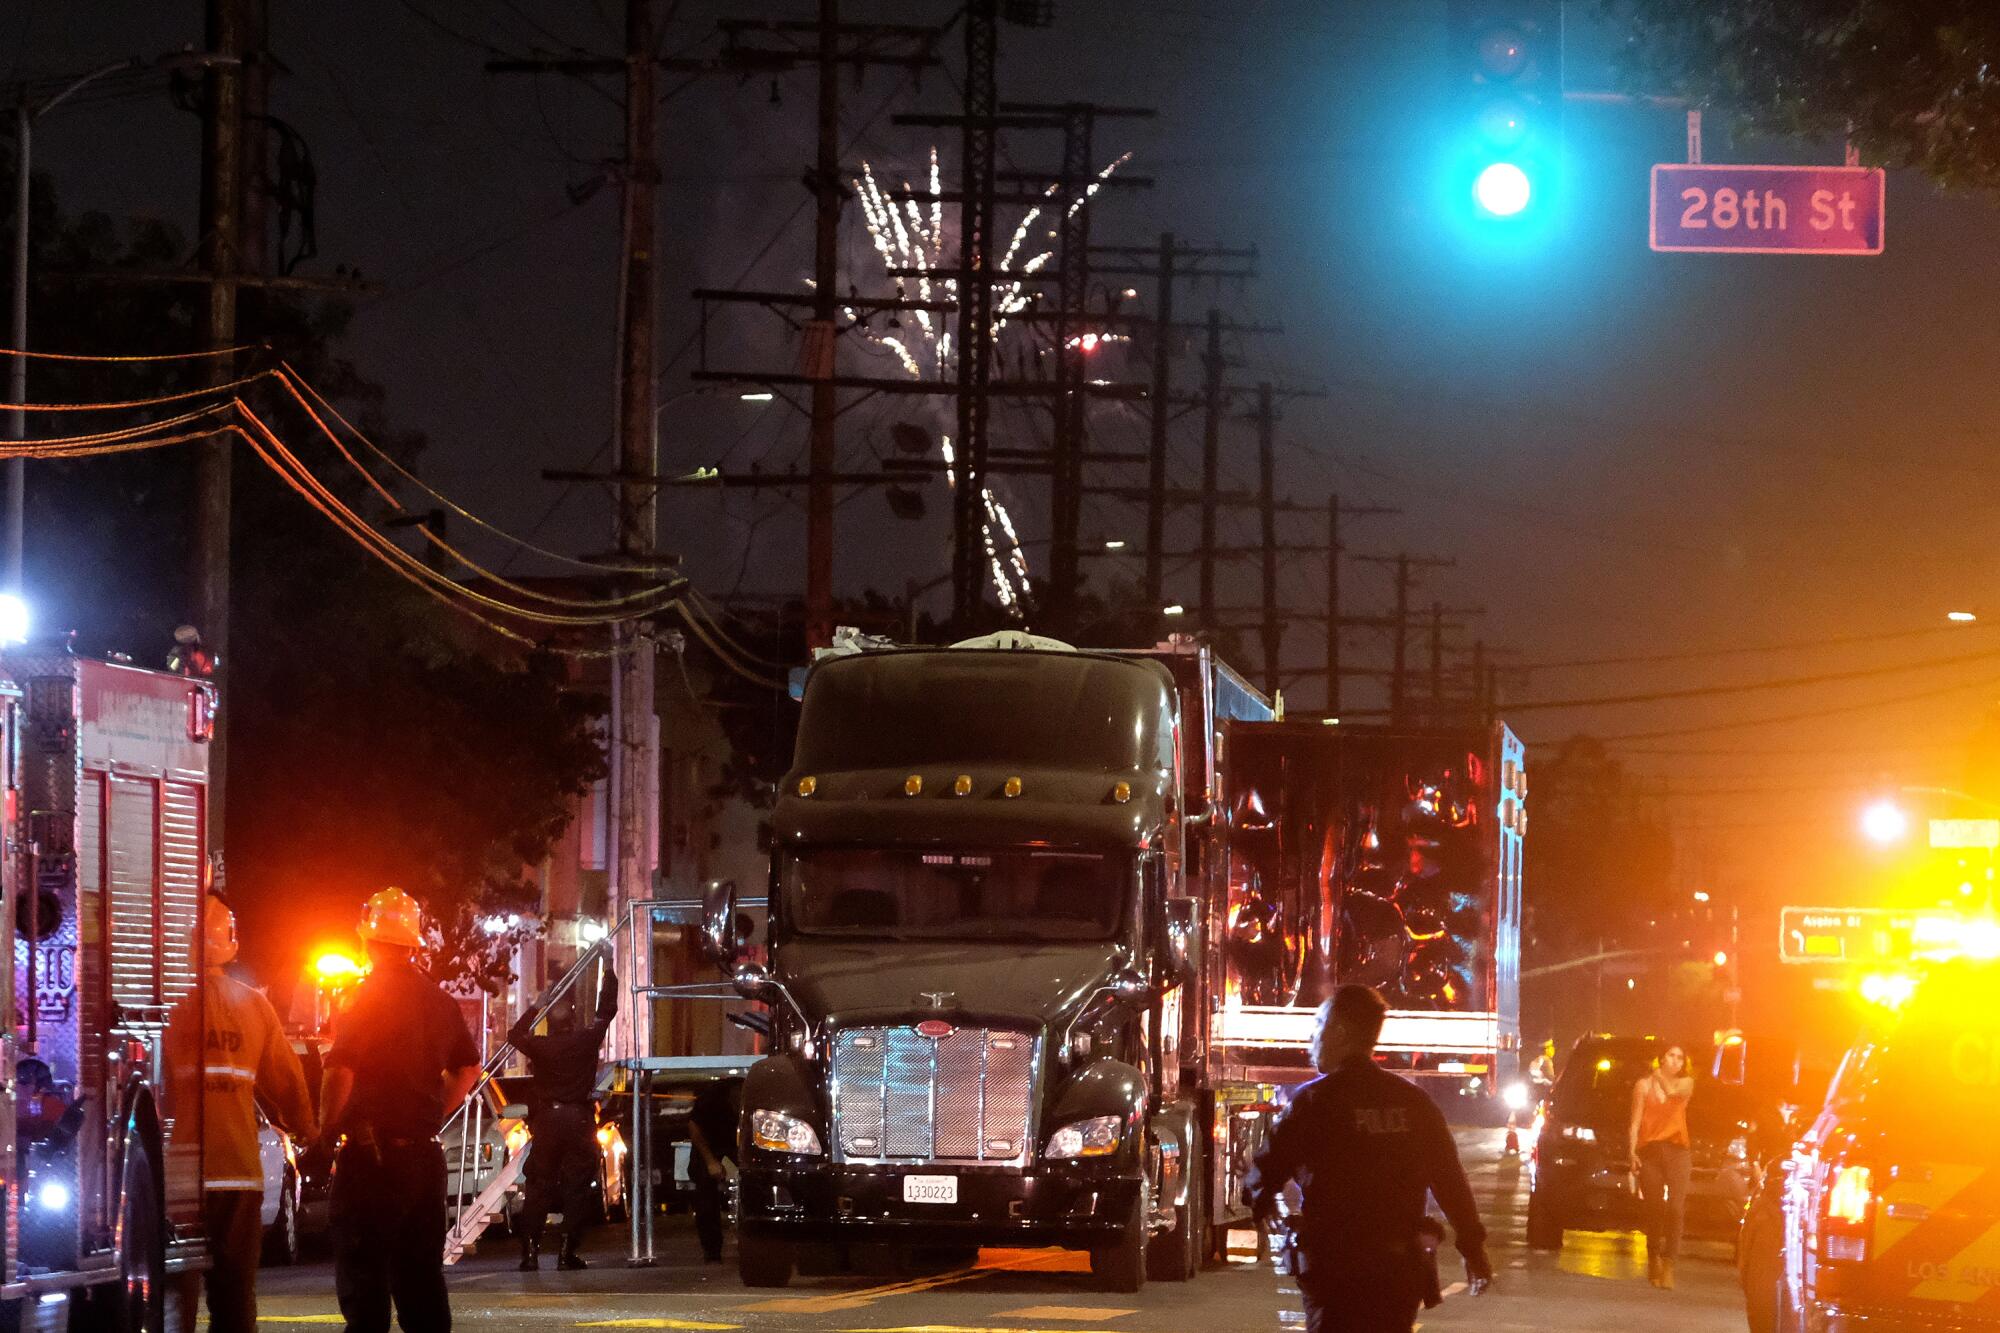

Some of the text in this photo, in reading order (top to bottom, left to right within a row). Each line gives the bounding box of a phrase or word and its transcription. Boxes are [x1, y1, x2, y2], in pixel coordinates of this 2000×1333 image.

[1680, 187, 1856, 231] 28th St
[206, 1027, 243, 1052] AFD
[1353, 1108, 1410, 1133] POLICE
[908, 1185, 953, 1199] 1330223
[1908, 1260, 1948, 1280] LOS
